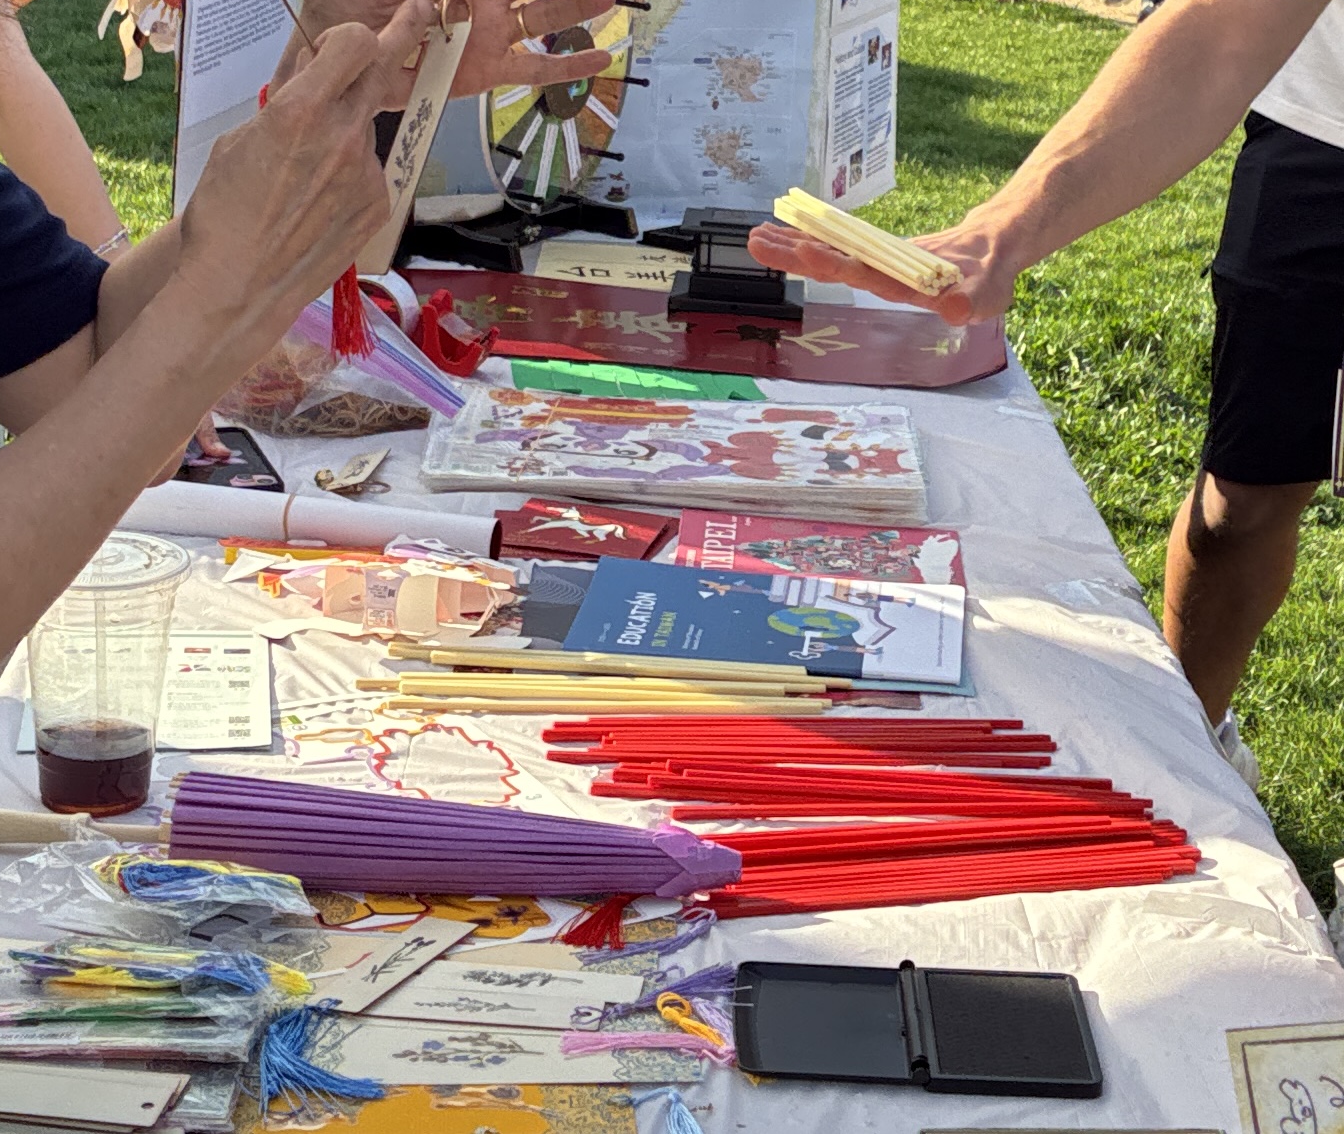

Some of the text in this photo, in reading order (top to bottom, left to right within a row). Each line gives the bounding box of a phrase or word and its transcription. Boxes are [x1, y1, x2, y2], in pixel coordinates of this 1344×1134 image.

[701, 520, 737, 569] TAIPEI
[617, 591, 657, 646] EDUCATION
[652, 612, 676, 648] IN TAIWAN
